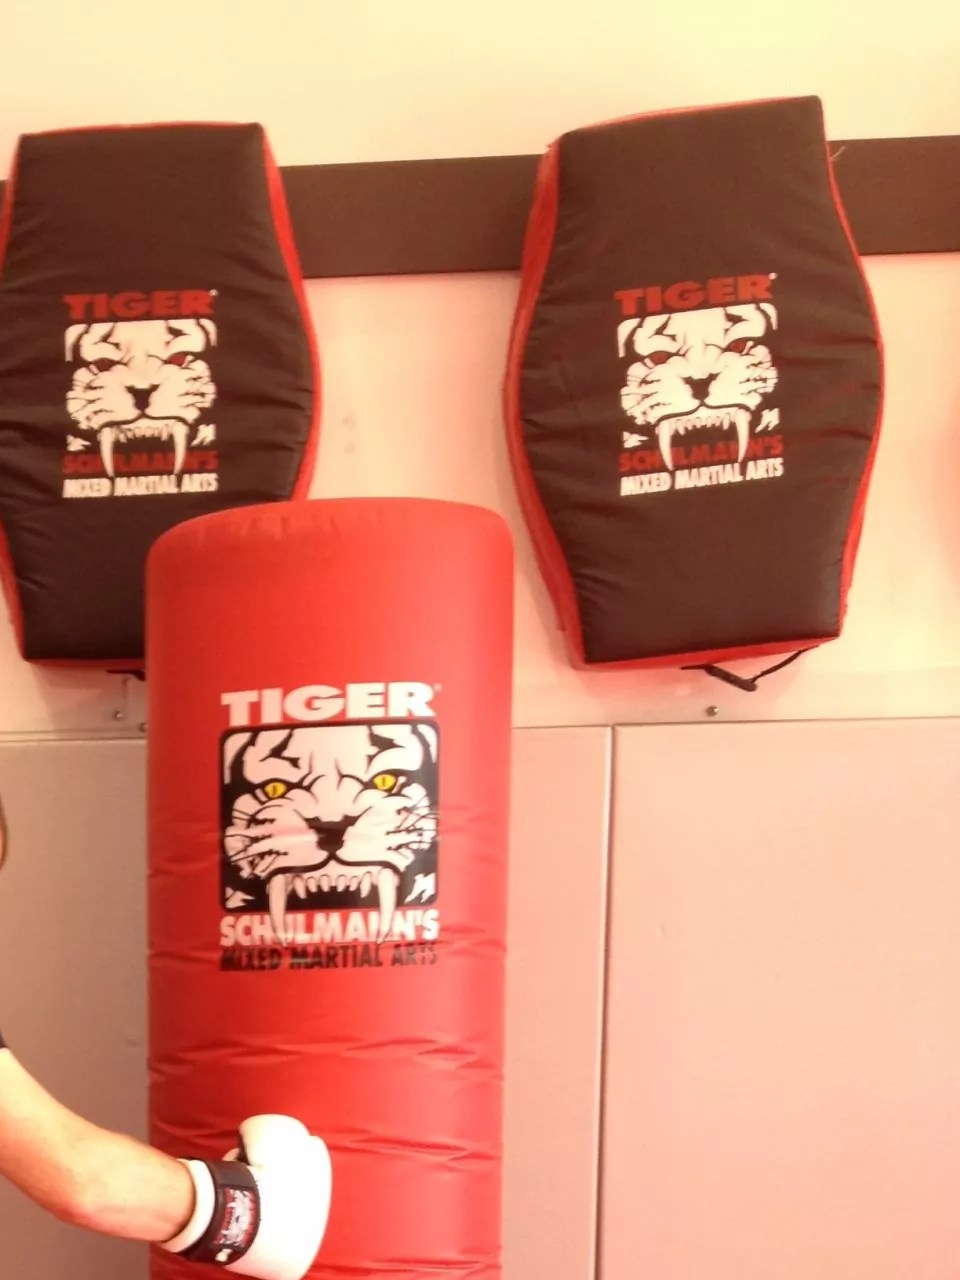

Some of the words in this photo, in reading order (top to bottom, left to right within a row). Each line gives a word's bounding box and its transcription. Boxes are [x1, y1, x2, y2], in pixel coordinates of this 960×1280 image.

[63, 289, 214, 320] TIGER
[614, 274, 772, 315] TIGER
[63, 451, 218, 475] SCHLMAN'S
[618, 435, 783, 472] SCHLMAN'S
[62, 477, 112, 498] MIXED
[113, 474, 179, 496] MARTIAL
[180, 473, 219, 492] ARTS
[620, 472, 672, 497] MIXED
[674, 462, 743, 490] MARTIAL
[745, 457, 784, 480] ARTS
[220, 681, 437, 727] TIGER
[219, 946, 283, 972] MIXED
[289, 943, 383, 970] MARTIAL
[391, 941, 438, 966] ARTS
